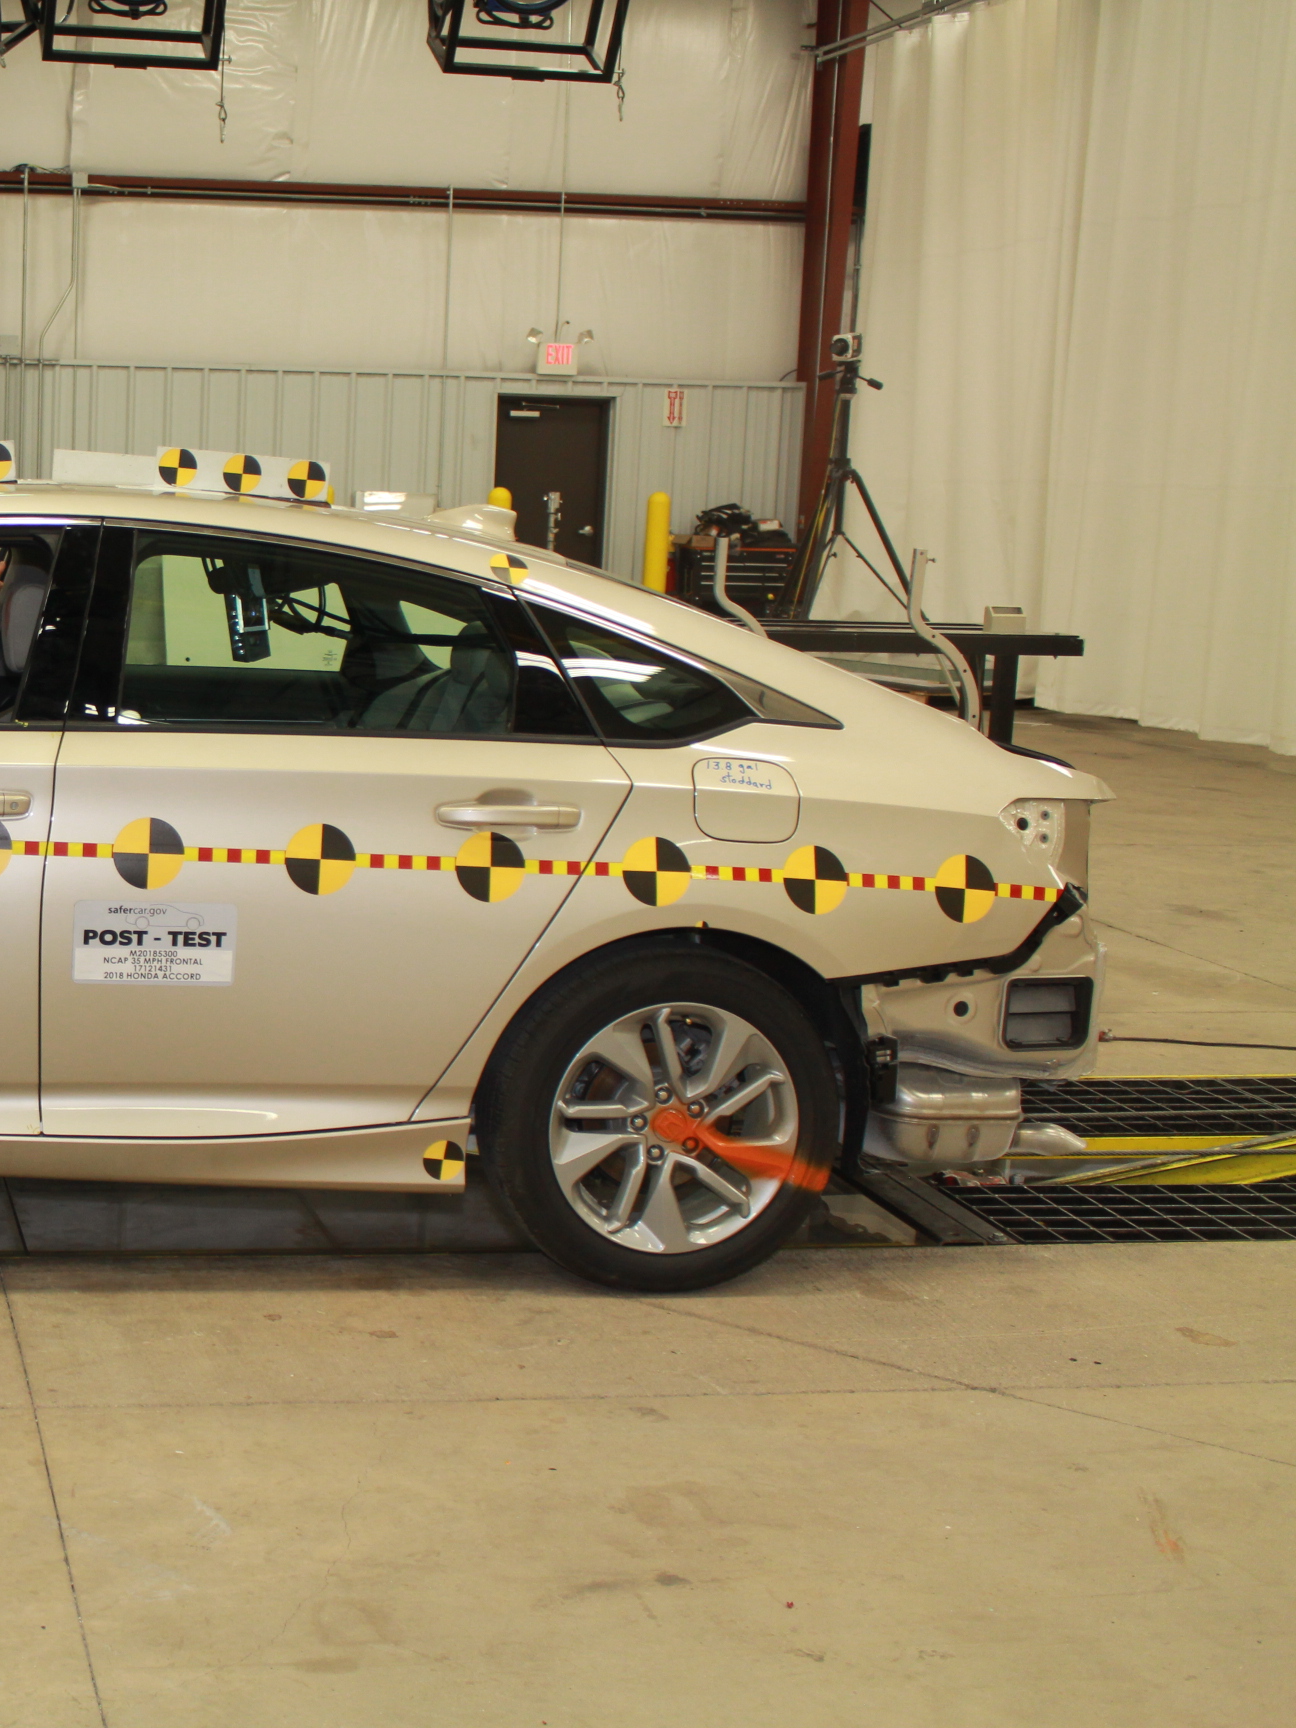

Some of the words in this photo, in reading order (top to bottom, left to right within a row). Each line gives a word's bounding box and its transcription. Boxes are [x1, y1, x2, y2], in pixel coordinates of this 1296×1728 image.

[545, 343, 574, 365] EXIT
[706, 761, 732, 771] 13.8
[738, 763, 758, 774] gal
[720, 772, 772, 790] stoddard
[108, 905, 167, 917] safercar.gov
[83, 929, 148, 946] POST
[167, 931, 227, 947] TEST
[129, 950, 178, 958] M20185300
[103, 957, 129, 965] NCAP
[131, 957, 141, 965] 35
[165, 958, 203, 966] FRONTAL
[133, 965, 173, 973] 17121431
[126, 972, 159, 980] HONDA
[161, 973, 201, 981] ACCORD
